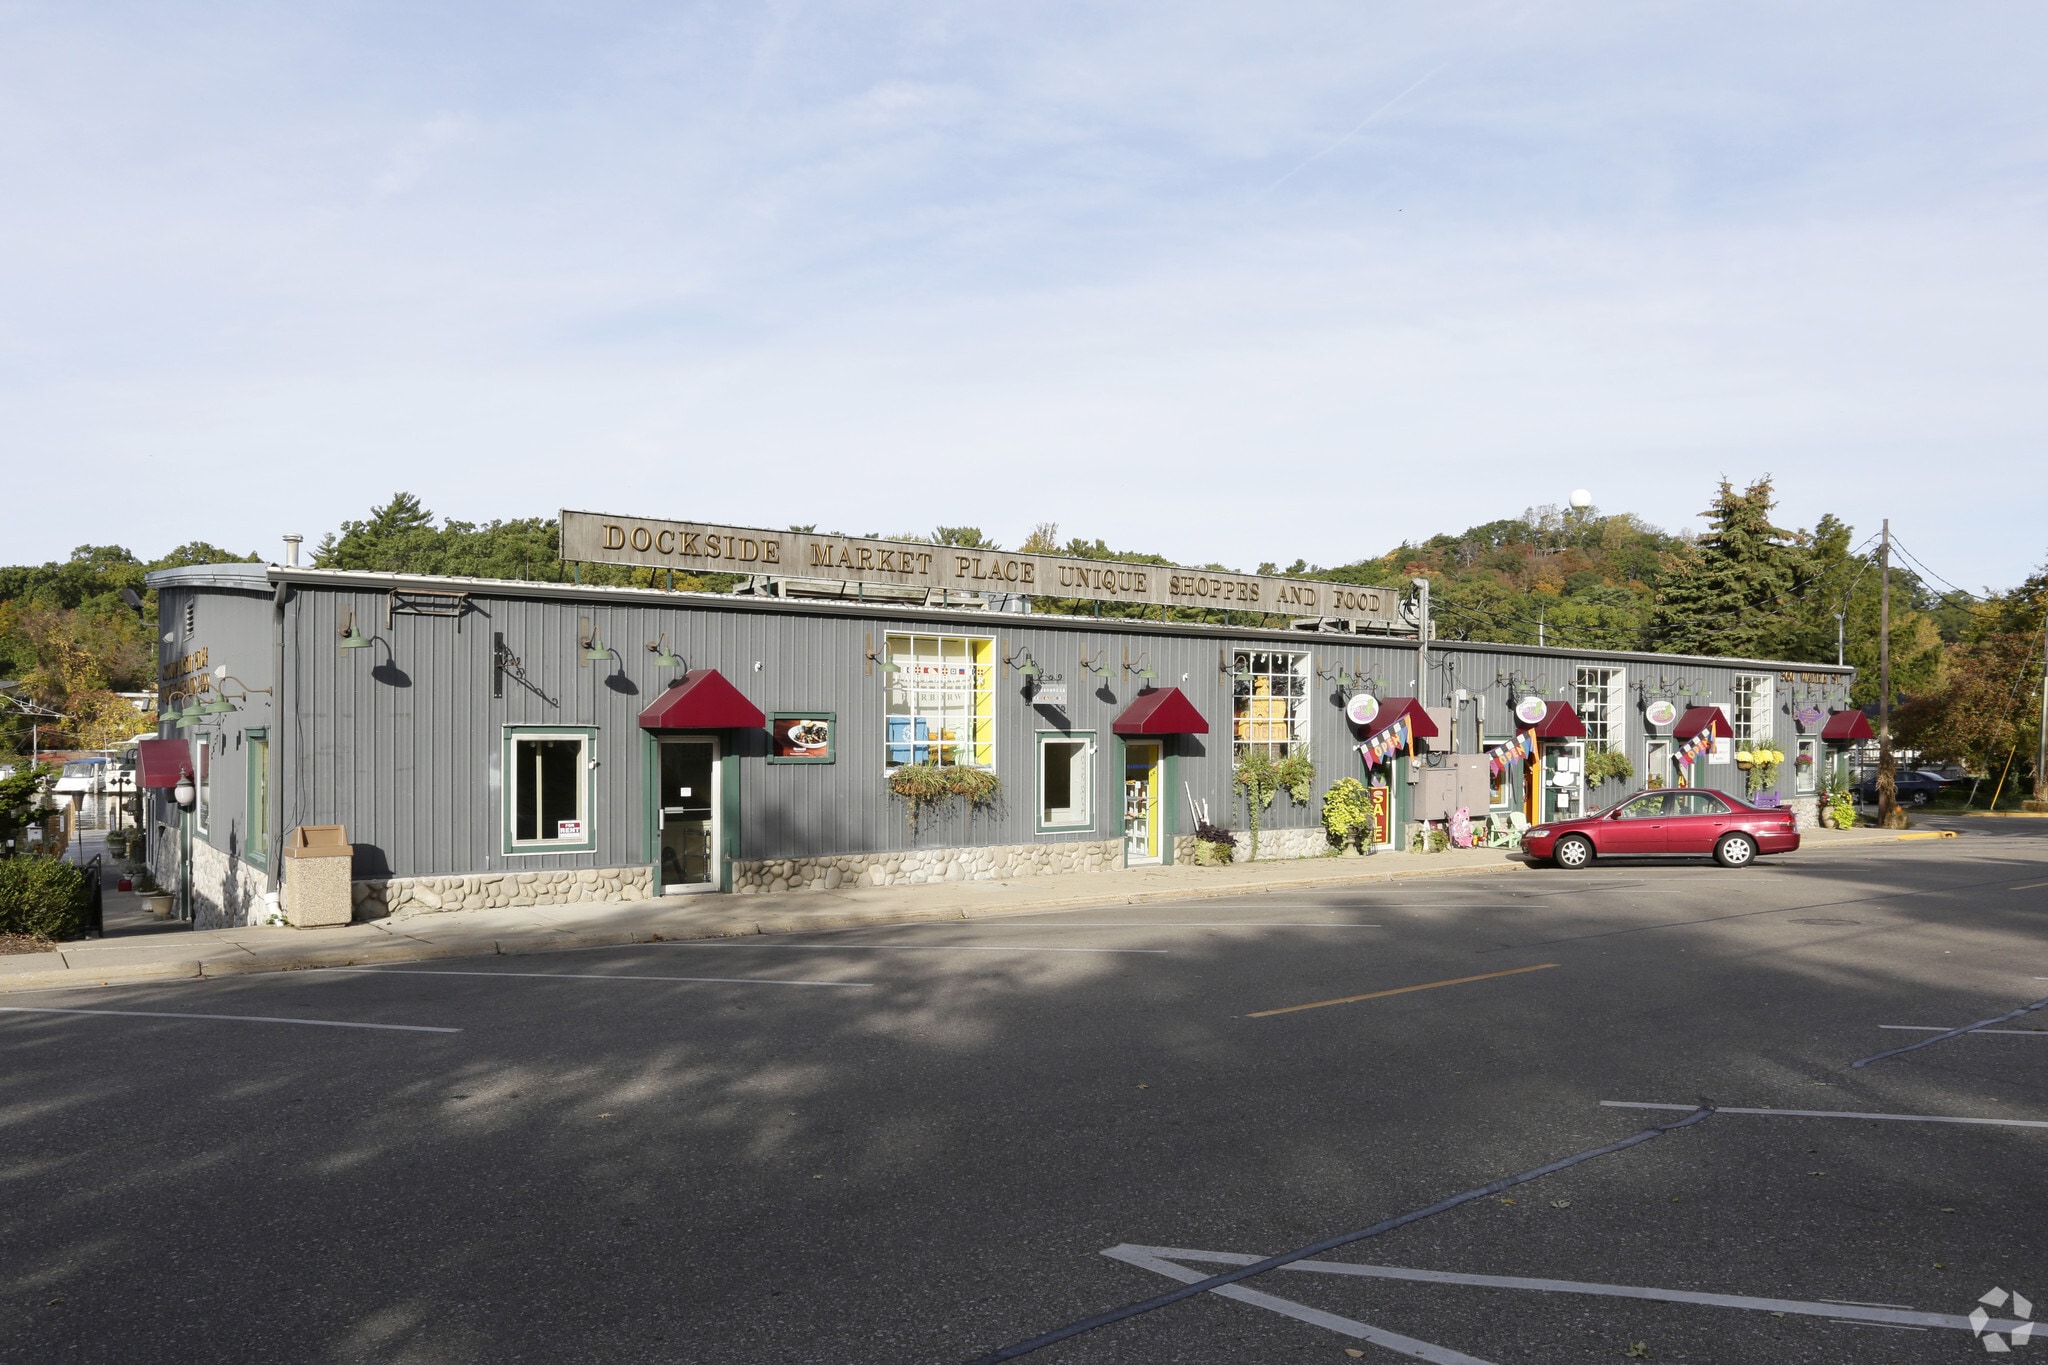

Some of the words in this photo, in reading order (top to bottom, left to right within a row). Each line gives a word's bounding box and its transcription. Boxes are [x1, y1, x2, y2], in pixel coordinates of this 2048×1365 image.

[602, 524, 780, 564] DOCKSIDE
[811, 543, 933, 575] MARKET
[955, 556, 1035, 583] PLACE
[1058, 565, 1147, 594] UNIQUE
[1168, 574, 1260, 601] SHOPPES
[1276, 585, 1316, 606] AND
[1333, 590, 1381, 612] FOOD
[1374, 733, 1401, 757] OPEN
[1499, 744, 1526, 765] OPEN
[1373, 790, 1384, 842] SALE
